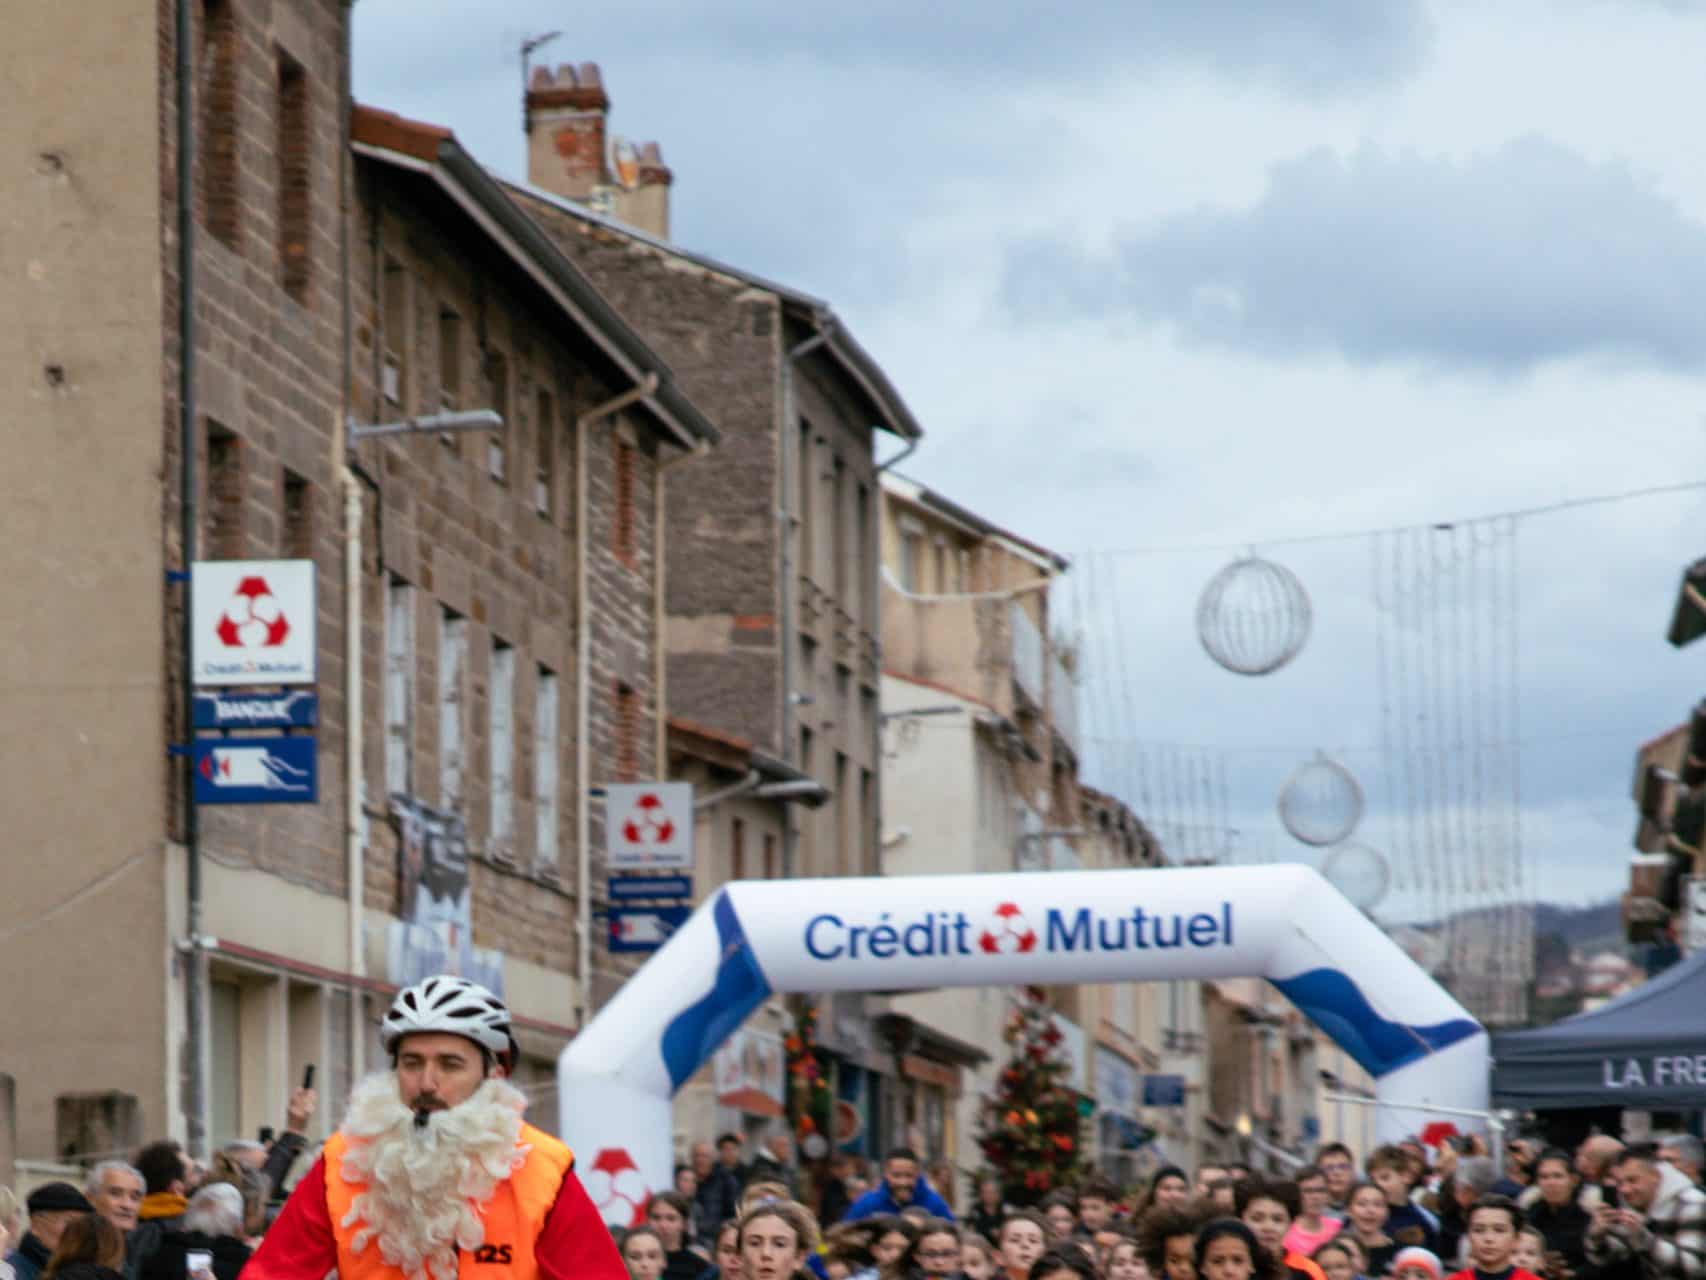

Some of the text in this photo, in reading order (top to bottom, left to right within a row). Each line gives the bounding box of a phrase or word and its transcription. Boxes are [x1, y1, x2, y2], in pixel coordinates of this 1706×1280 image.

[803, 902, 1233, 960] Crédit Mutuel
[1602, 1058, 1646, 1088] LA
